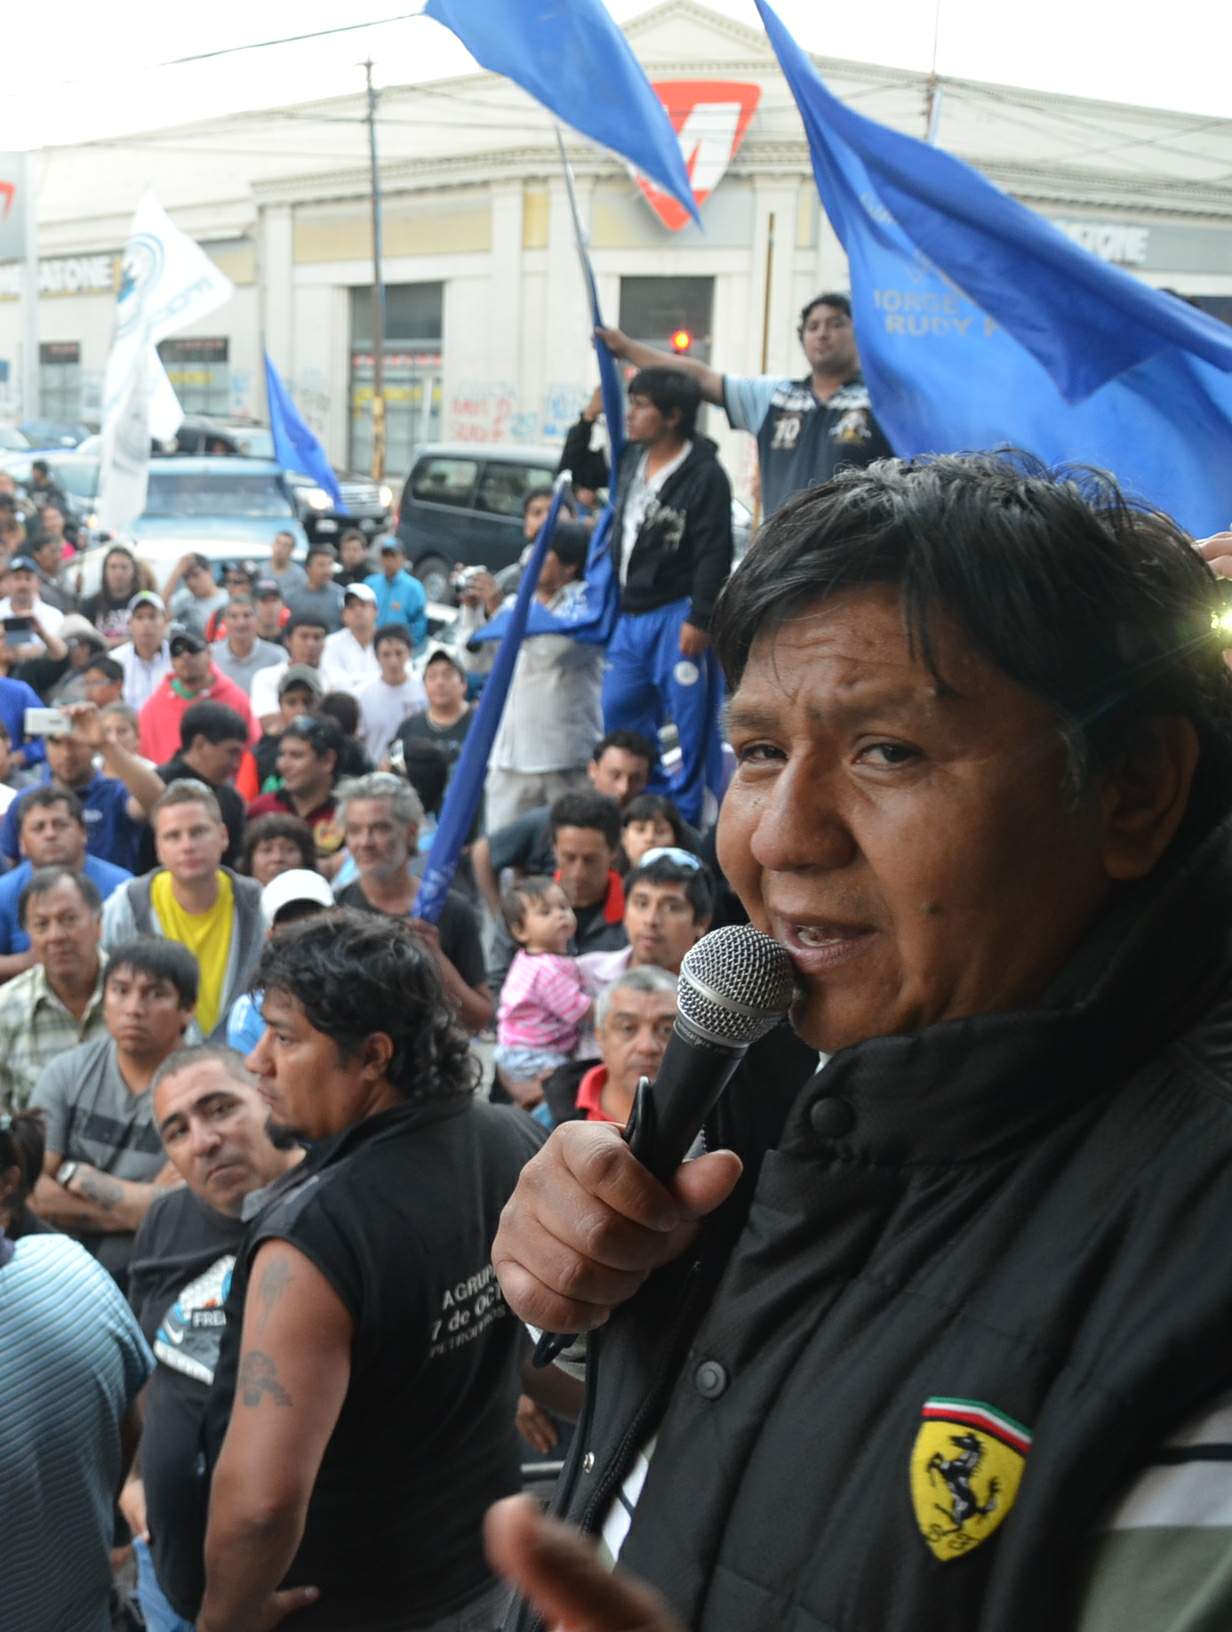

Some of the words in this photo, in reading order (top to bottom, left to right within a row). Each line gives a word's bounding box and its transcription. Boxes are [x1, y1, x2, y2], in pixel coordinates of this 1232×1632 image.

[431, 1318, 443, 1342] 7
[448, 1308, 471, 1332] de
[474, 1282, 503, 1317] OCT
